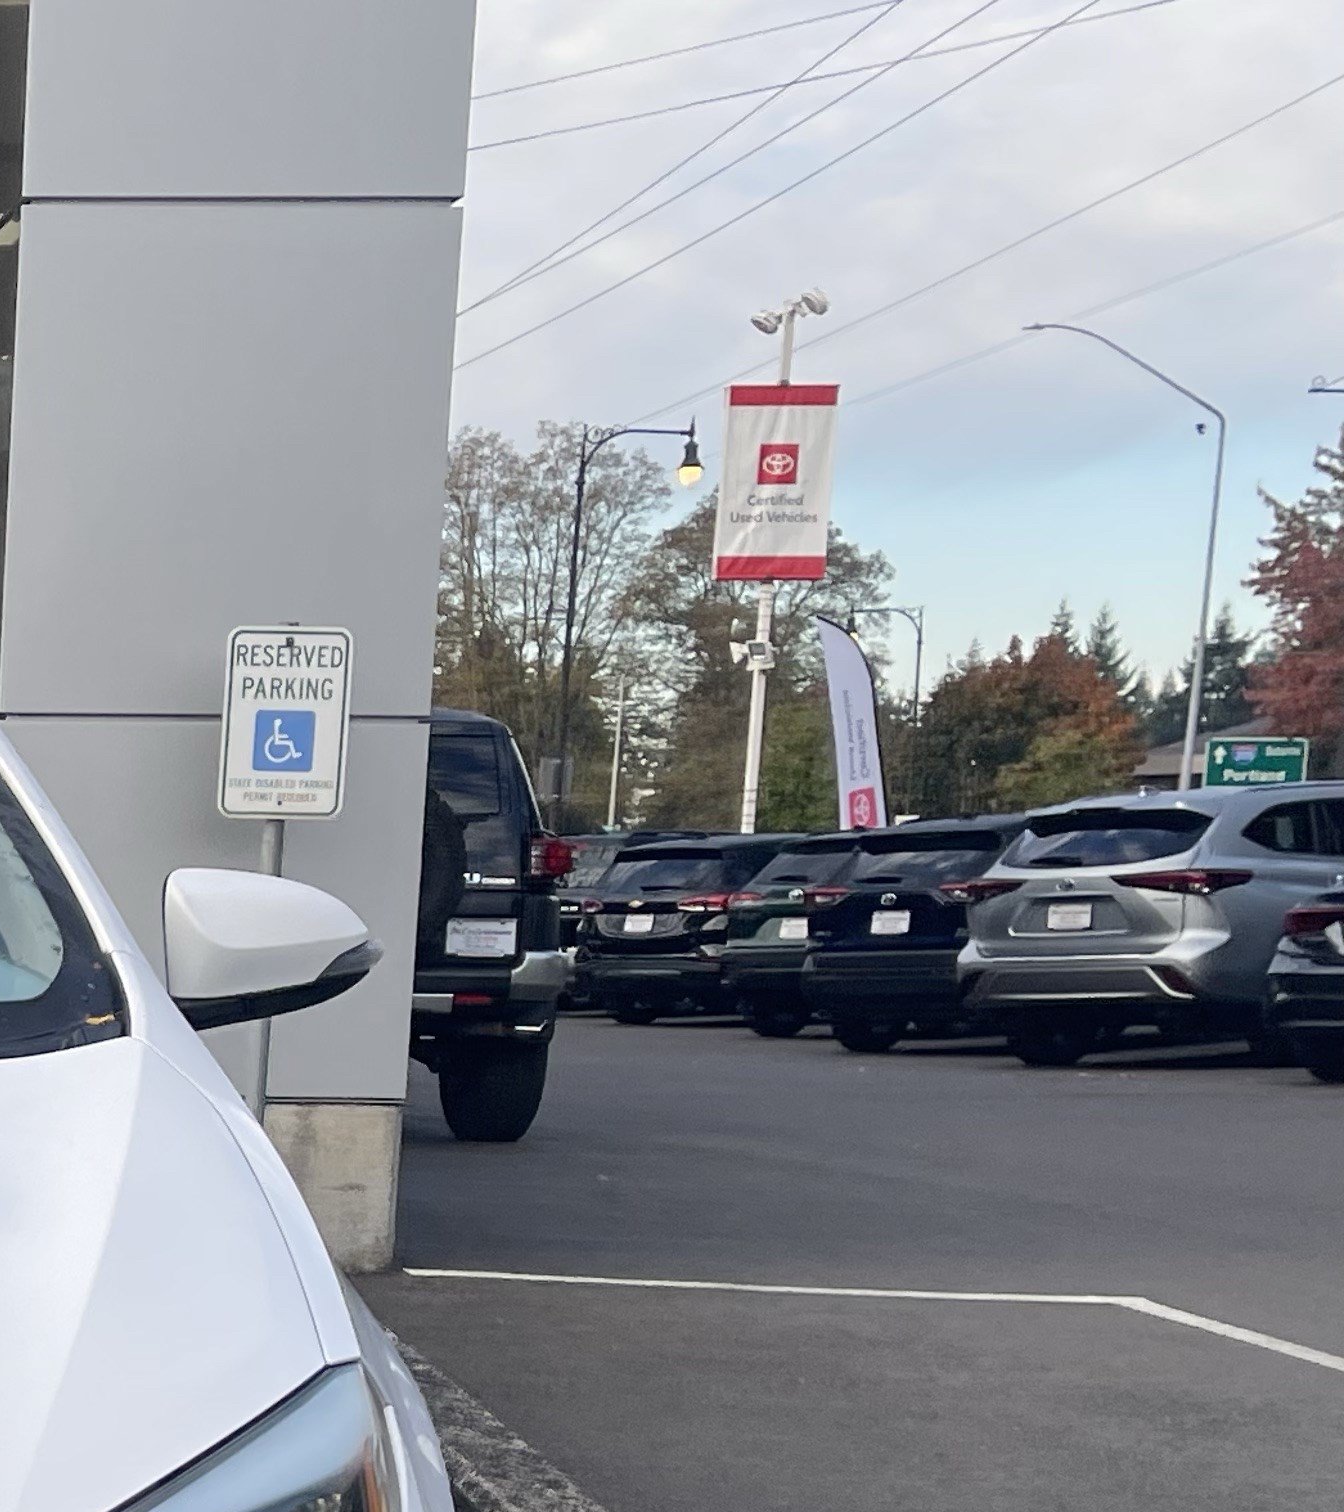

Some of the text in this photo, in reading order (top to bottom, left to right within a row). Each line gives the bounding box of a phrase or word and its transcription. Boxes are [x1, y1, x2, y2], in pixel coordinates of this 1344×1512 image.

[746, 494, 805, 506] Certified
[730, 511, 818, 523] Used Vehicles
[235, 644, 344, 668] RESERVED
[240, 676, 334, 701] PARKING
